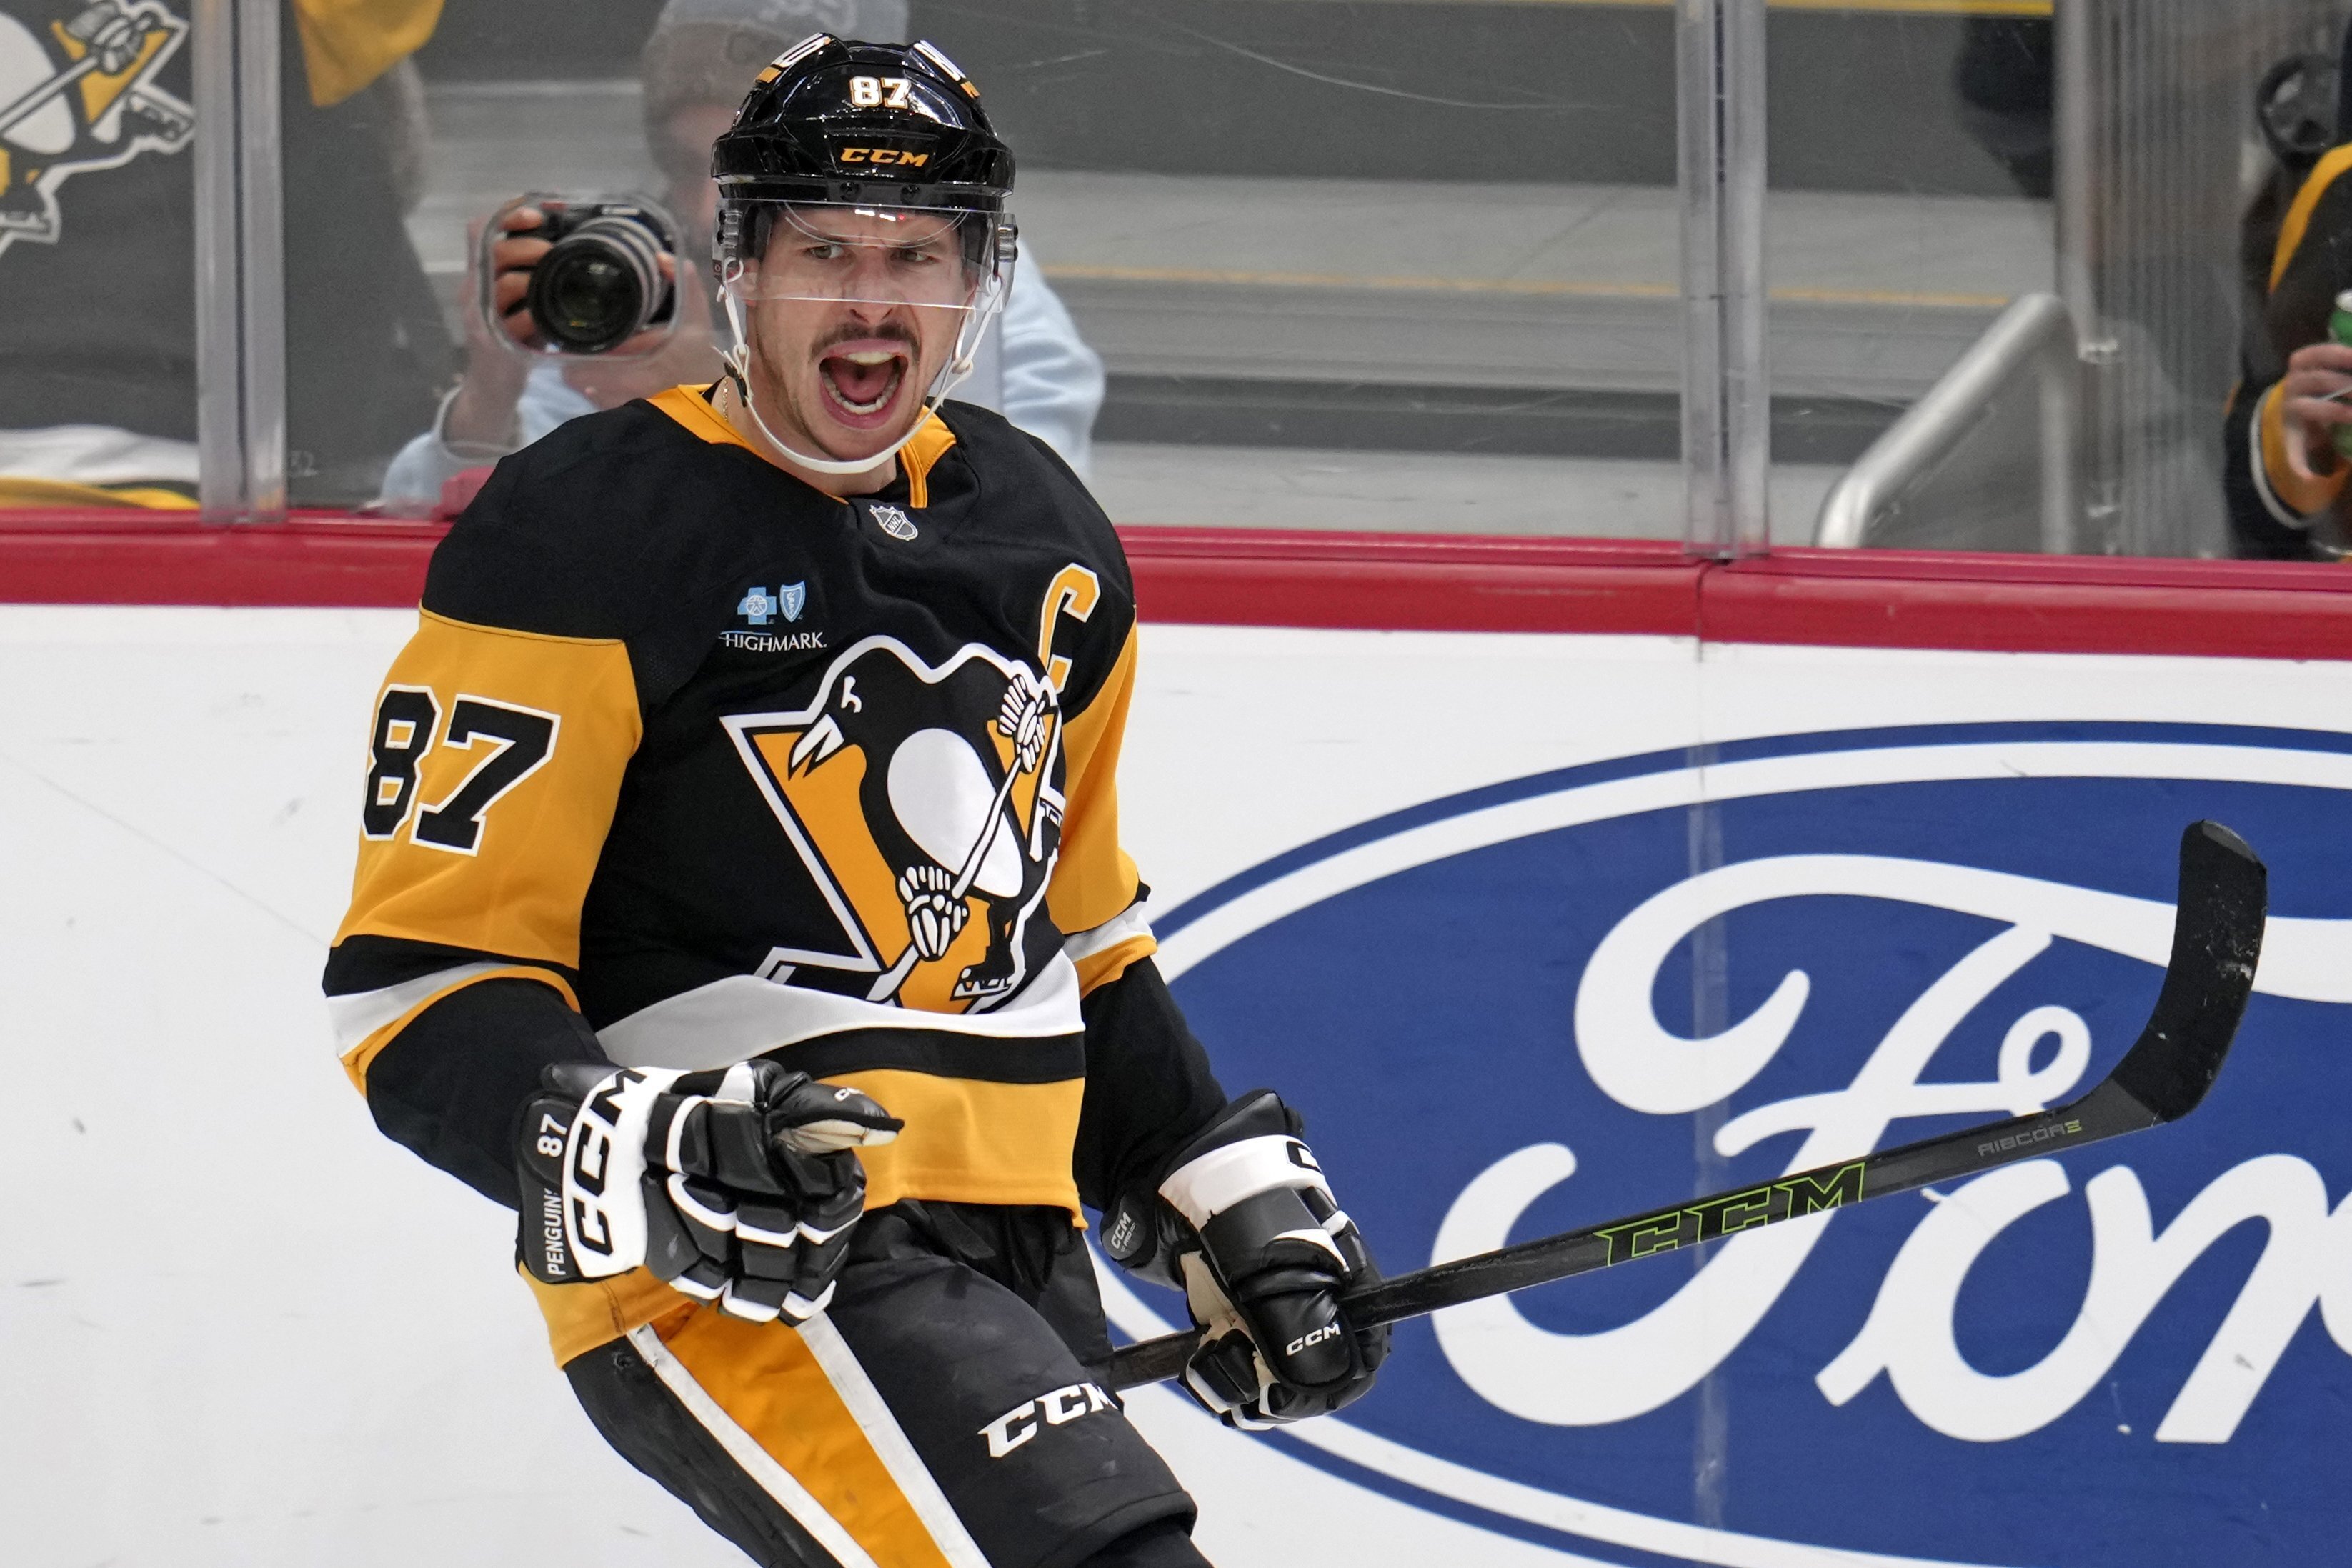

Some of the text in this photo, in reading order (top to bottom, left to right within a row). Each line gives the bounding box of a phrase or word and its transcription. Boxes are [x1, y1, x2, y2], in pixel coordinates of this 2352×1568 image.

[848, 76, 912, 109] 87
[839, 147, 929, 168] CCM
[887, 515, 902, 533] NHL
[1038, 562, 1101, 695] C
[361, 683, 562, 857] 87
[537, 1114, 568, 1158] 87
[1429, 853, 2352, 1444] For
[572, 1069, 648, 1257] CCM
[1110, 1211, 1132, 1249] CCM
[1593, 1162, 1866, 1267] CCM
[1286, 1322, 1342, 1357] CCM
